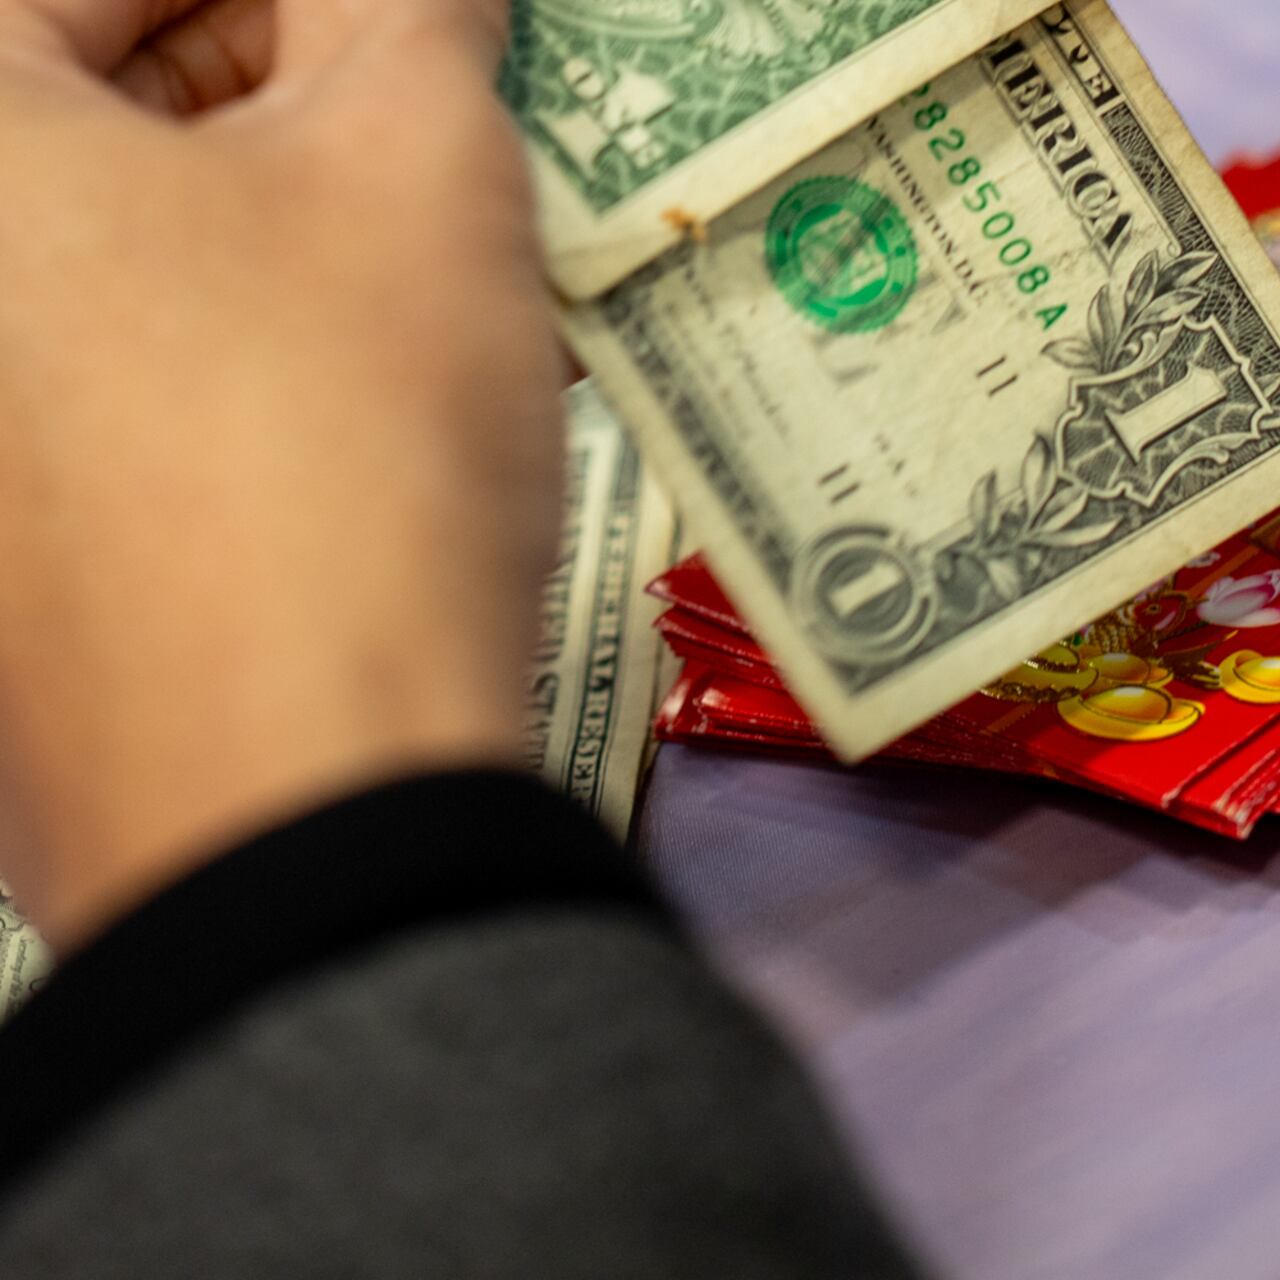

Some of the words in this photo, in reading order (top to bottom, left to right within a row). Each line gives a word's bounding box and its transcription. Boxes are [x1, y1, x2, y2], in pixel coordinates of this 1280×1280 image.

[564, 63, 664, 166] ONE
[1106, 367, 1228, 463] 1
[830, 562, 905, 617] 1
[571, 688, 609, 802] RESER
